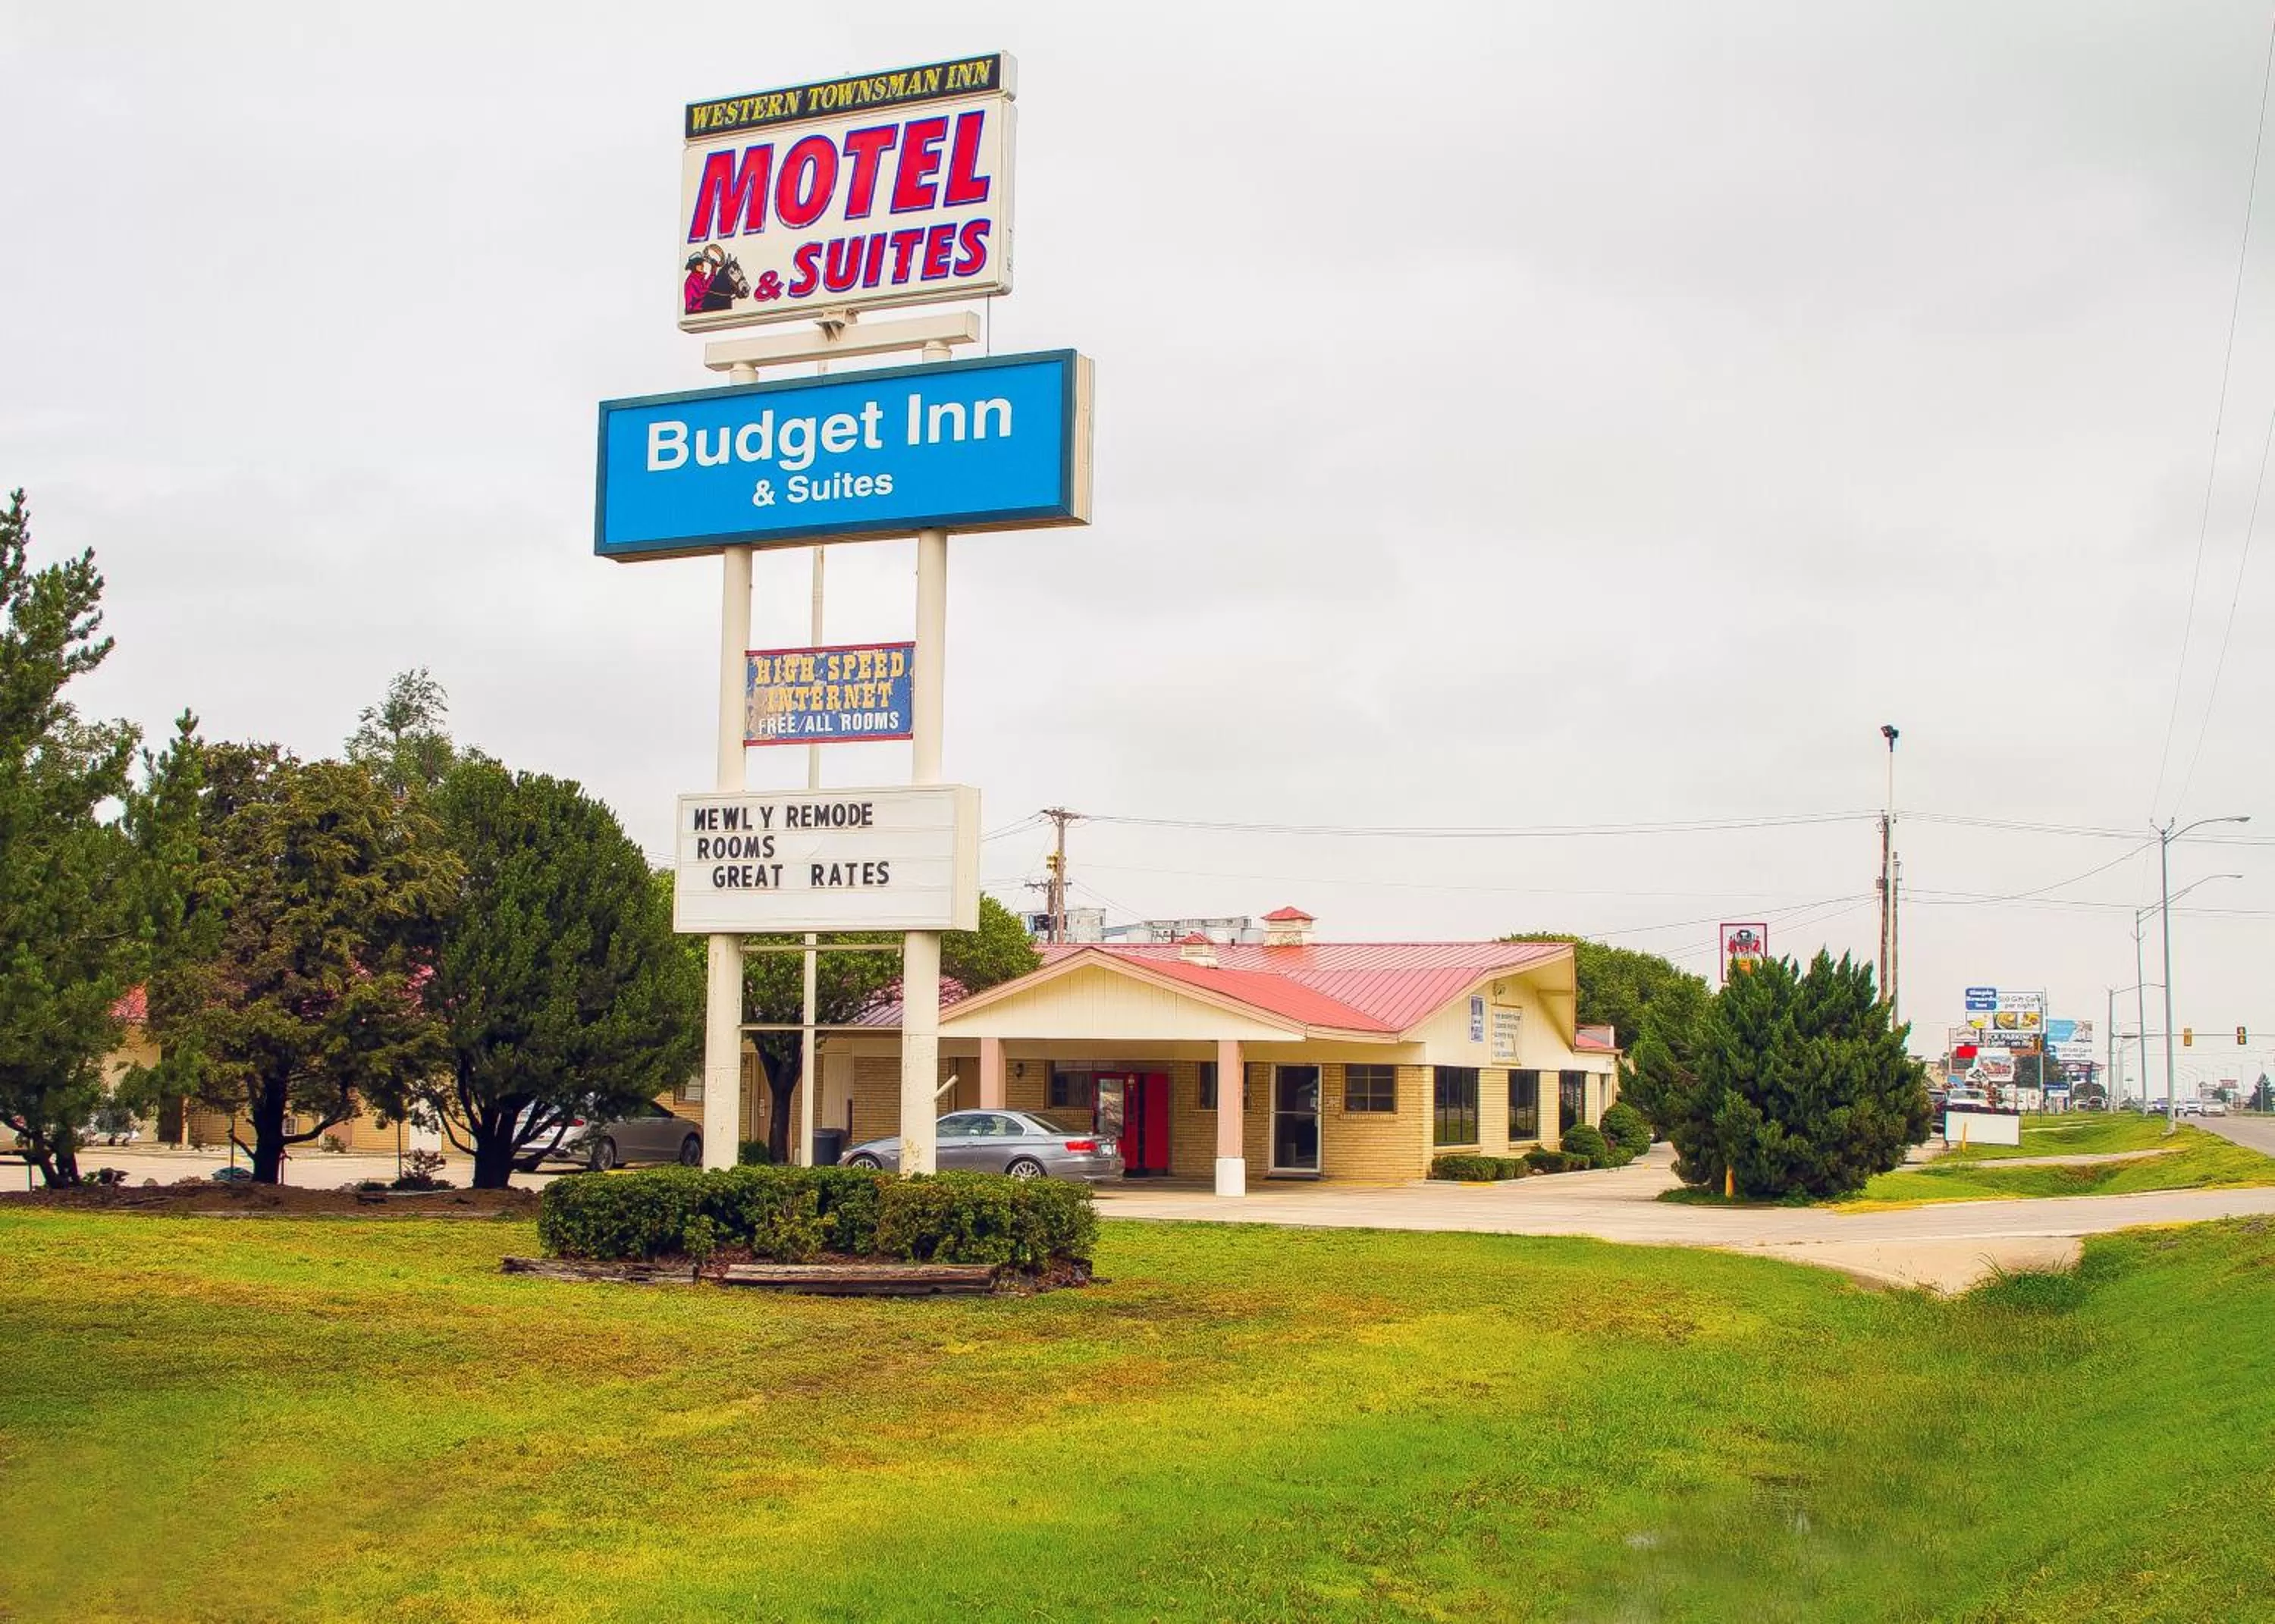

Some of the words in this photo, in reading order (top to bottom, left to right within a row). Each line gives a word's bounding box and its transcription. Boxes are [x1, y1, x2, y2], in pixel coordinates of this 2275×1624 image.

[691, 90, 803, 131] WESTERN
[808, 66, 944, 112] TOWNSMAN
[945, 59, 993, 88] INN
[687, 109, 991, 243] MOTEL
[754, 270, 786, 302] &
[788, 218, 991, 298] SUITES
[646, 400, 883, 472] Budget
[907, 394, 1012, 446] Inn
[752, 479, 776, 507] &
[787, 472, 893, 503] Suites
[755, 656, 816, 684] HIGH
[827, 652, 905, 681] SPEED
[766, 681, 893, 712] INTERNET
[758, 715, 833, 735] FREE/ALL
[841, 711, 899, 731] ROOMS
[786, 802, 874, 828] REMODE
[697, 835, 775, 859] ROOMS
[712, 864, 783, 888] GREAT
[811, 861, 890, 887] RATES
